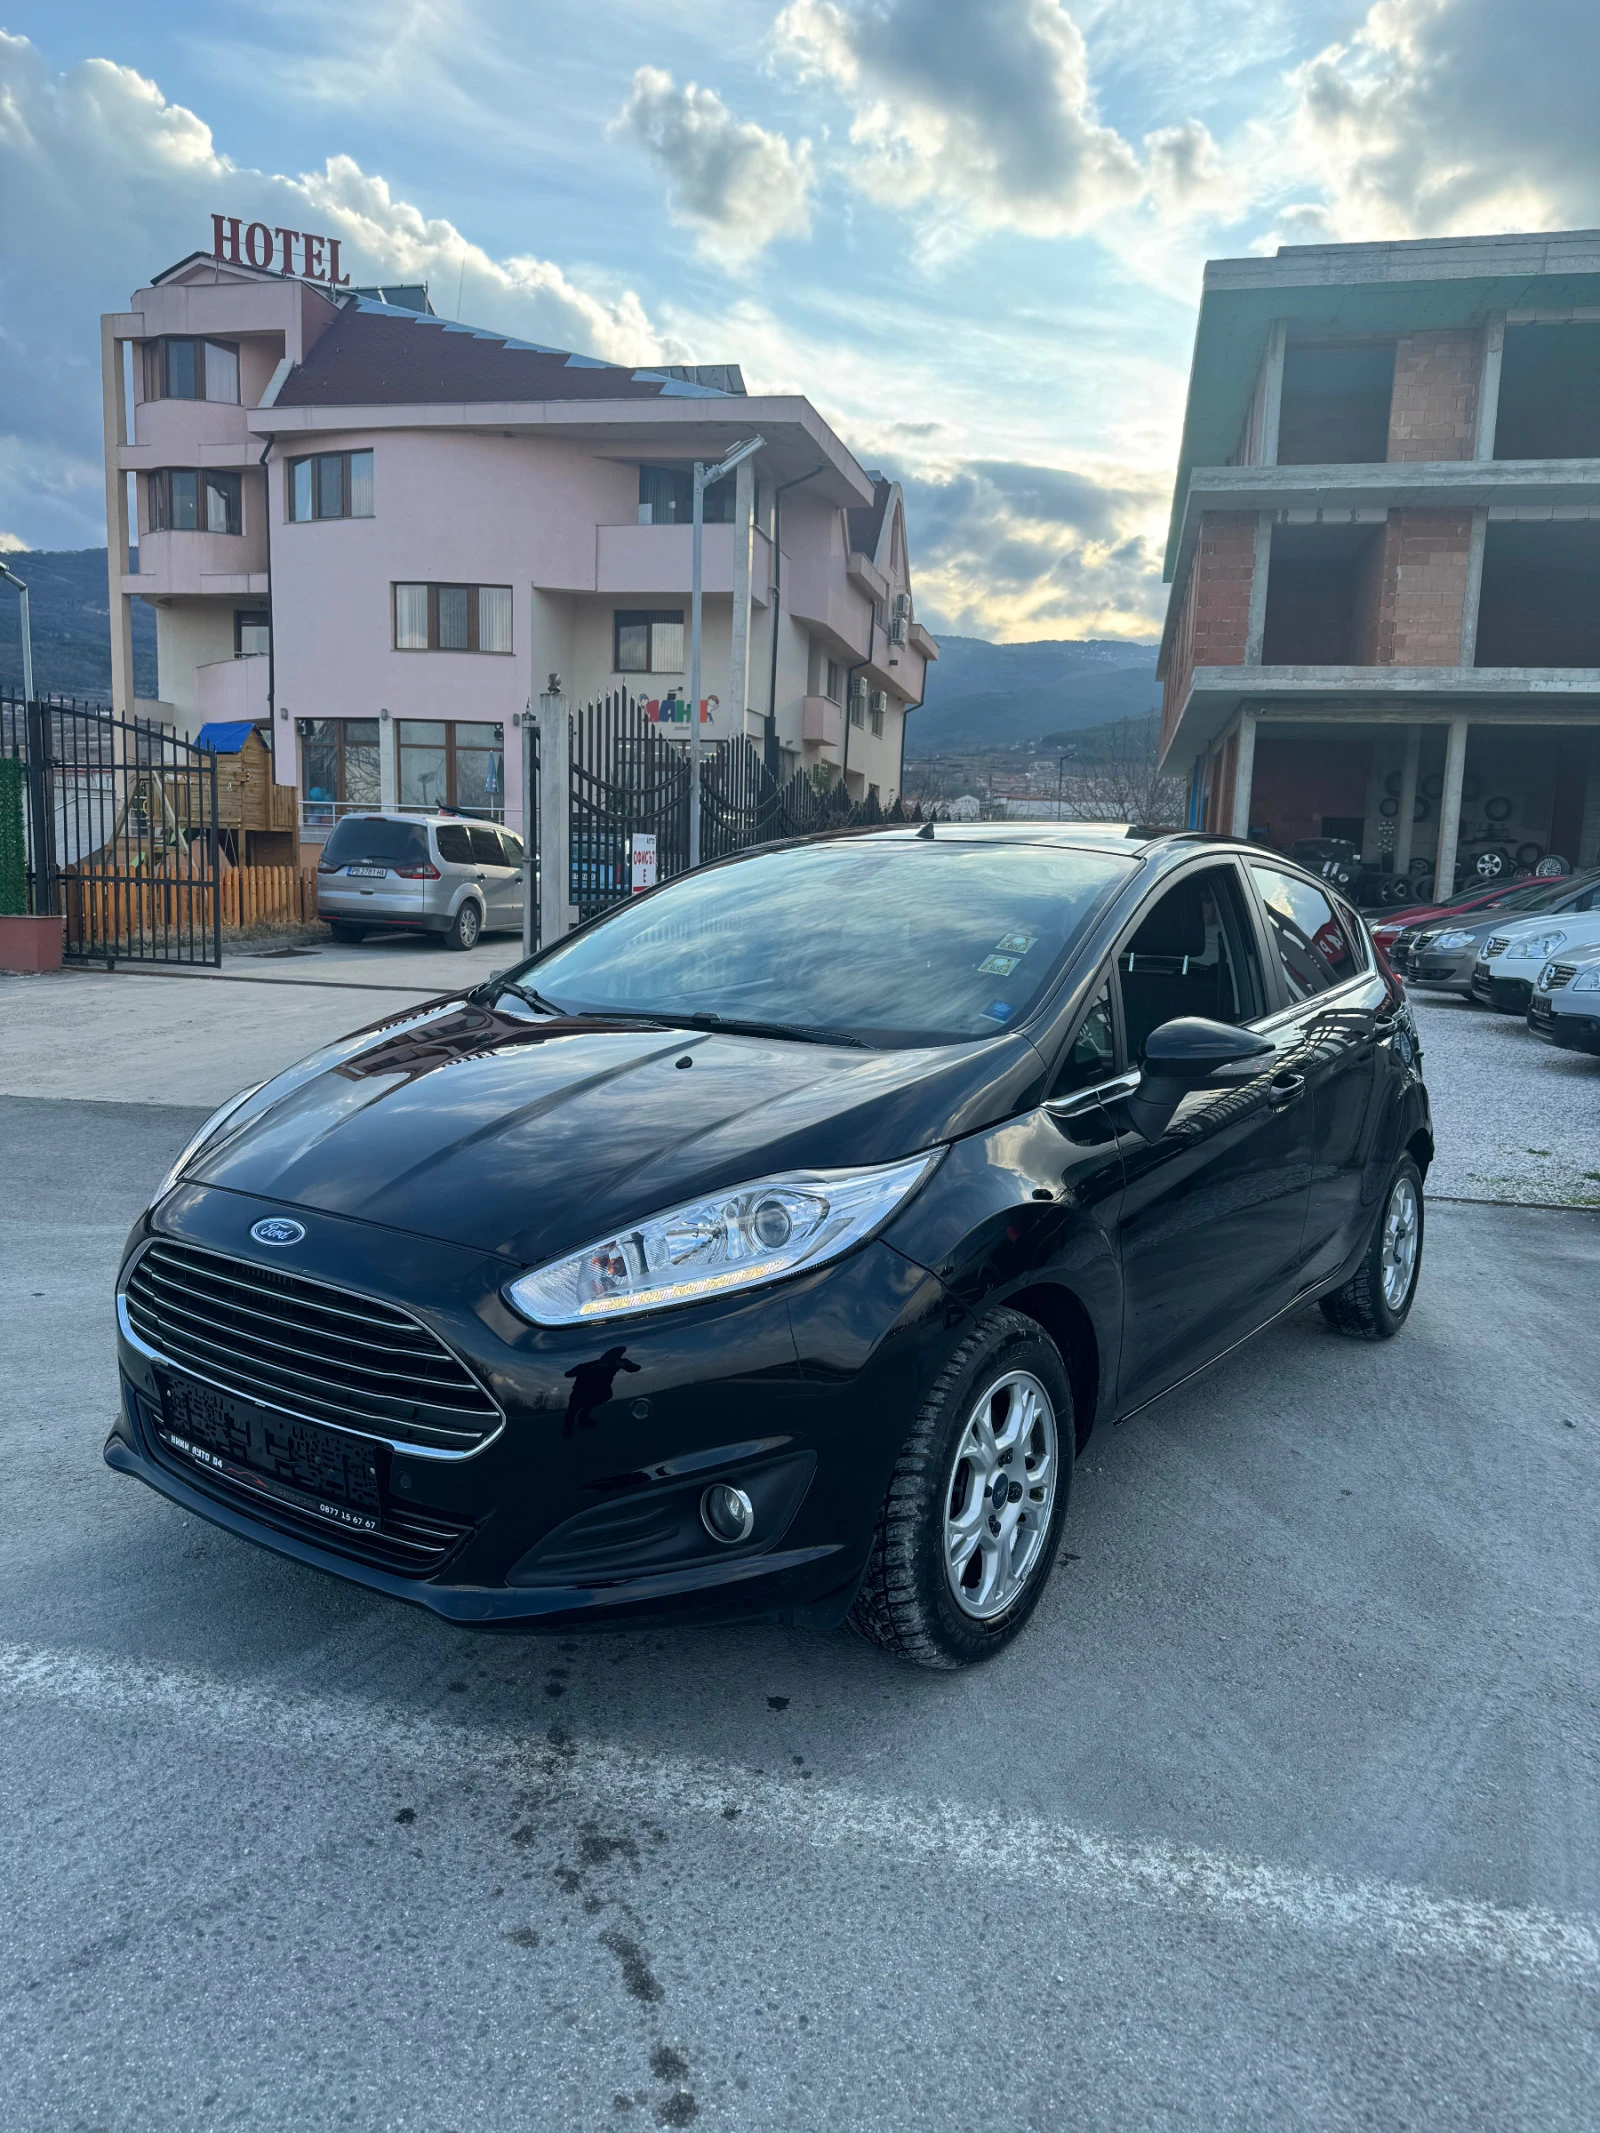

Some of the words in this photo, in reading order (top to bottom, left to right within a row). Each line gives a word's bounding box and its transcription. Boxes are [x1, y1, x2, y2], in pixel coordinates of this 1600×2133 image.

[211, 214, 350, 286] HOTEL
[633, 850, 655, 865] ОФИСЪТ
[170, 1434, 190, 1451] НИКИ
[192, 1446, 210, 1462] АУТО
[319, 1503, 339, 1516] 0877
[341, 1511, 351, 1521] 15
[352, 1516, 362, 1525] 67
[365, 1520, 376, 1529] 67
